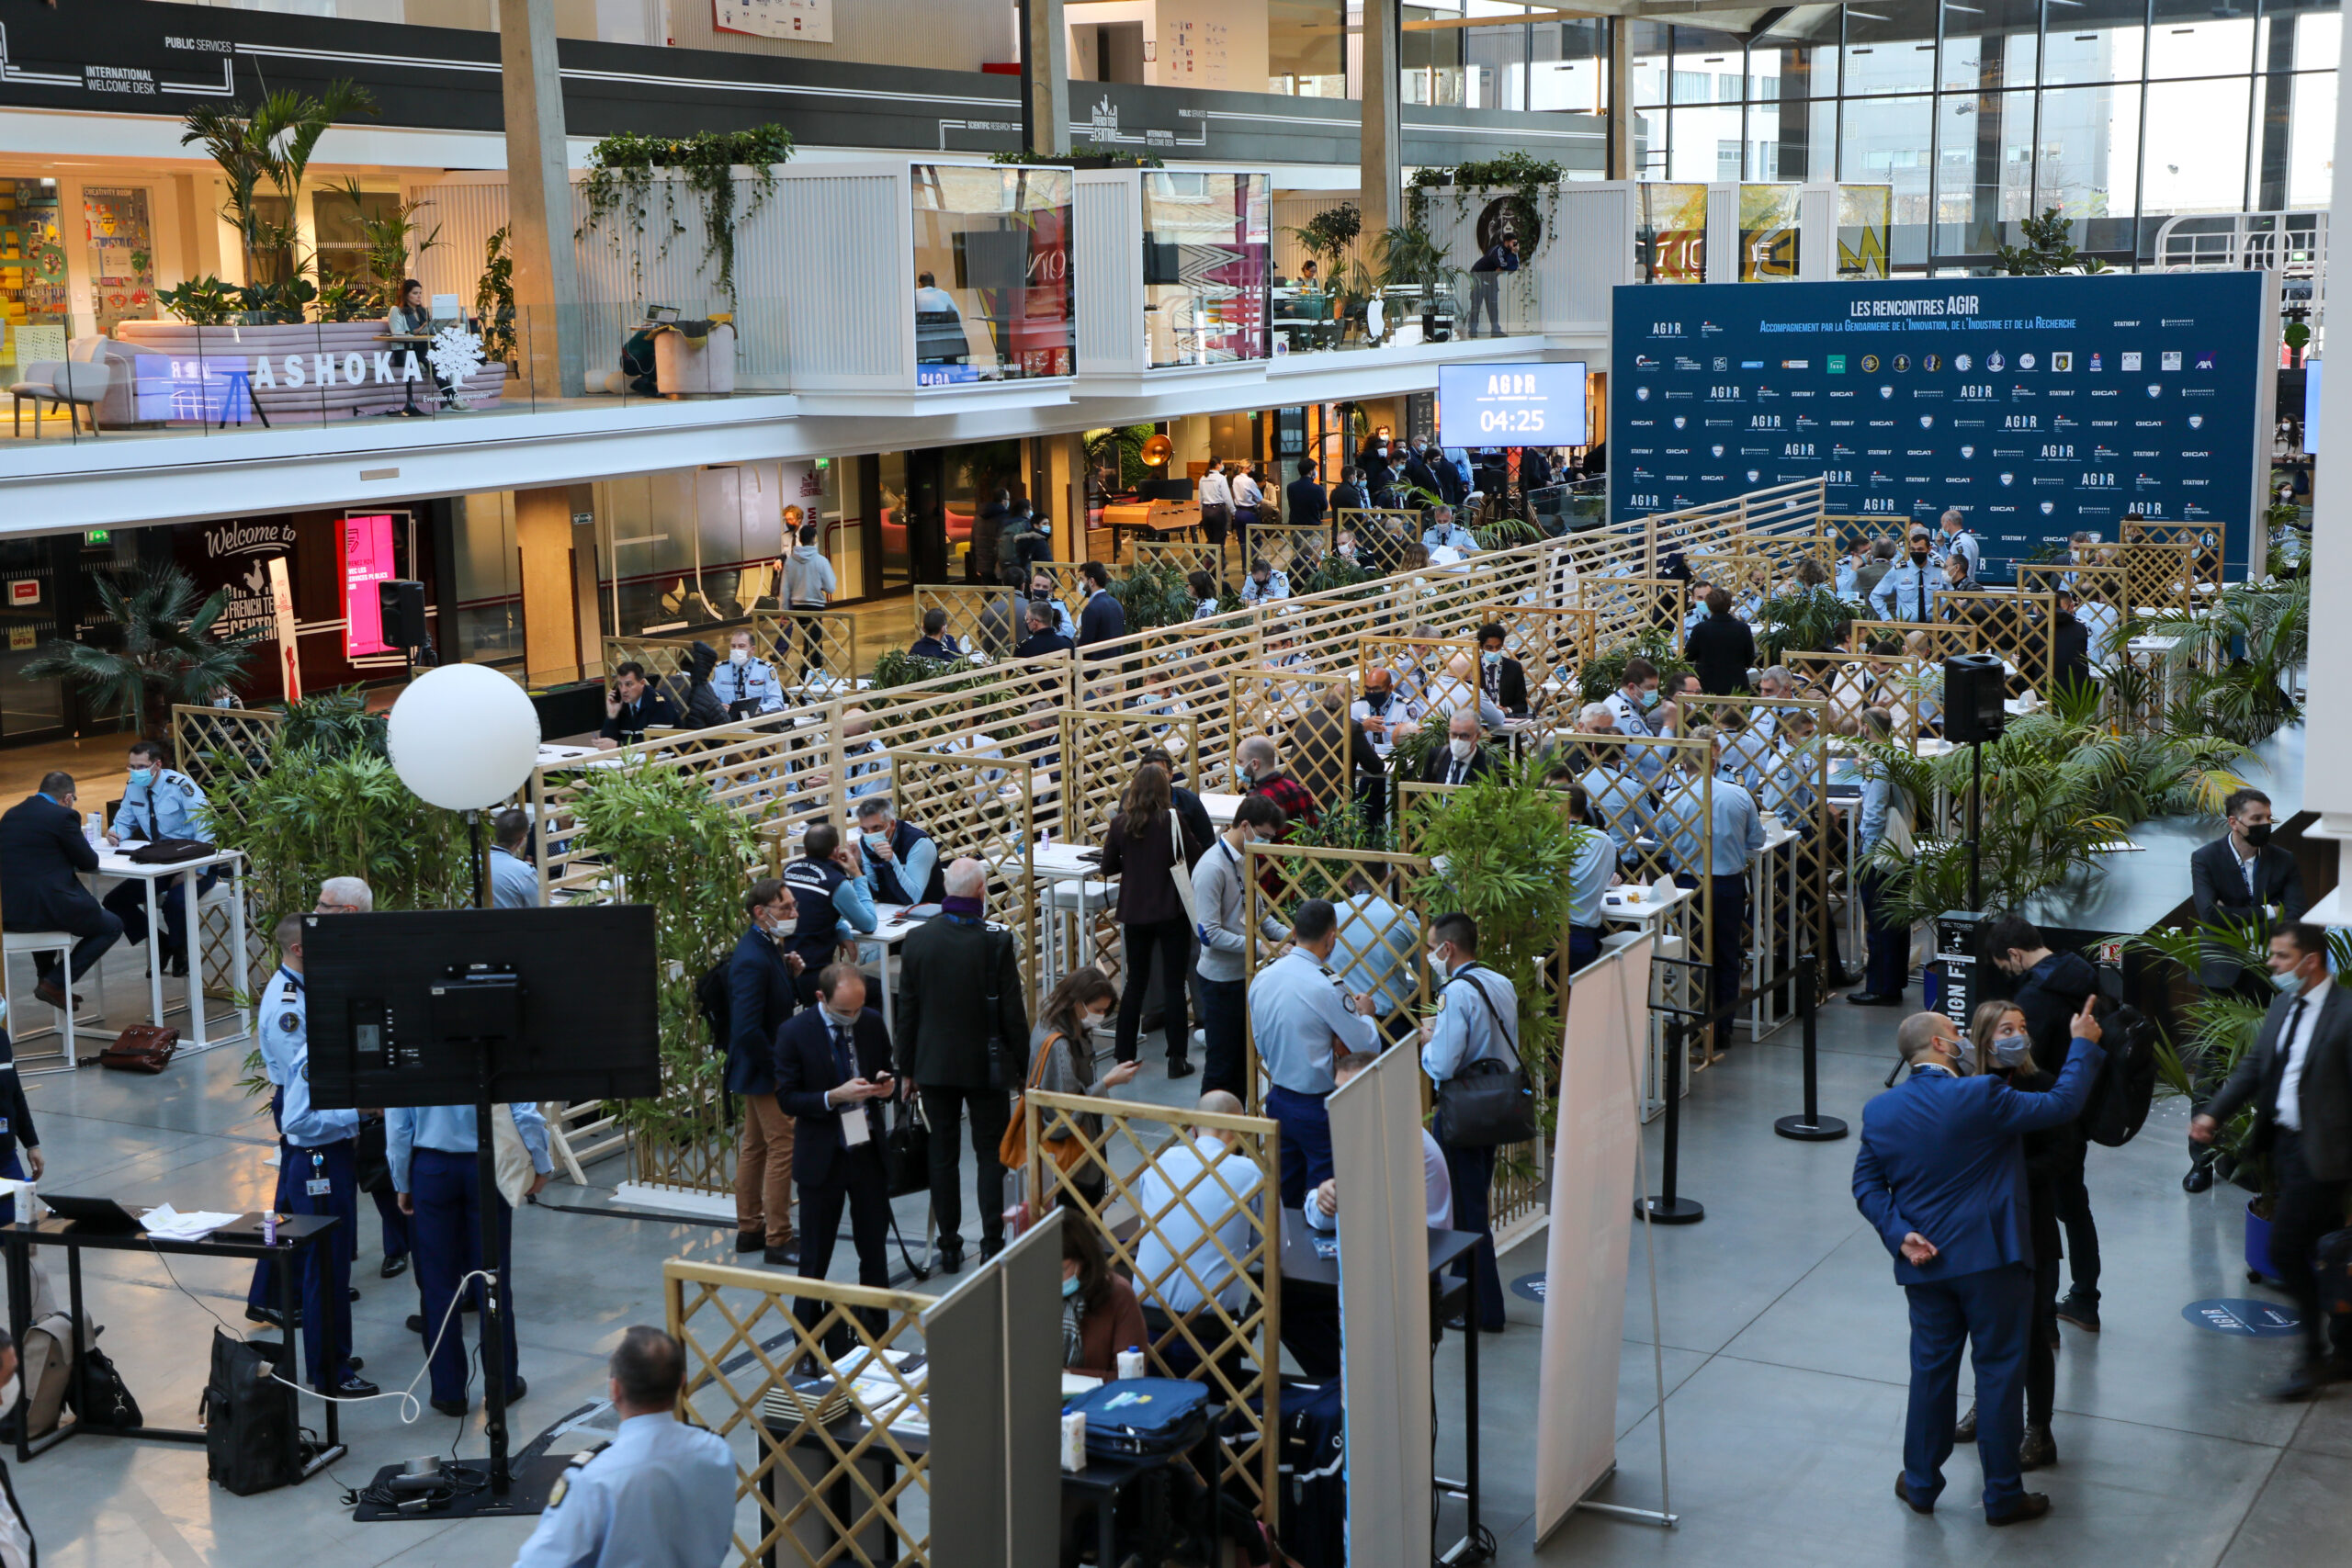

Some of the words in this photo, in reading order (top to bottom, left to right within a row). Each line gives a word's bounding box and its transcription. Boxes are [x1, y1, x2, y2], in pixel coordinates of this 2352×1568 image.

[165, 37, 195, 50] PUBLIC
[197, 39, 232, 52] SERVICES
[86, 66, 153, 82] INTERNATIONAL
[87, 80, 131, 93] WELCOME
[133, 82, 156, 95] DESK
[967, 121, 989, 130] SCIENTIFIC
[1850, 301, 1871, 316] LES
[1873, 299, 1944, 316] RENCONTRES
[1946, 296, 1979, 315] AGIR
[1653, 322, 1681, 334] AGIR
[254, 351, 423, 389] ASHOKA
[2196, 360, 2212, 368] AXA
[1487, 375, 1535, 395] AGIR
[1711, 387, 1739, 398] AGIR
[1961, 386, 1992, 397] AGIR
[1481, 410, 1544, 432] 04:25
[1751, 415, 1781, 427] AGIR
[2006, 416, 2037, 427] AGIR
[1785, 444, 1814, 456] AGIR
[2041, 446, 2074, 457] AGIR
[2082, 473, 2114, 485] AGIR
[1631, 495, 1658, 506] AGIR
[1864, 499, 1894, 510] AGIR
[2129, 502, 2161, 514] AGIR
[205, 521, 278, 558] Welcome
[282, 525, 296, 542] to
[348, 558, 362, 567] RENEZ
[348, 574, 368, 582] ERVICES
[368, 572, 388, 581] PUBLICS
[229, 597, 262, 618] FRENCH
[263, 595, 276, 614] TE
